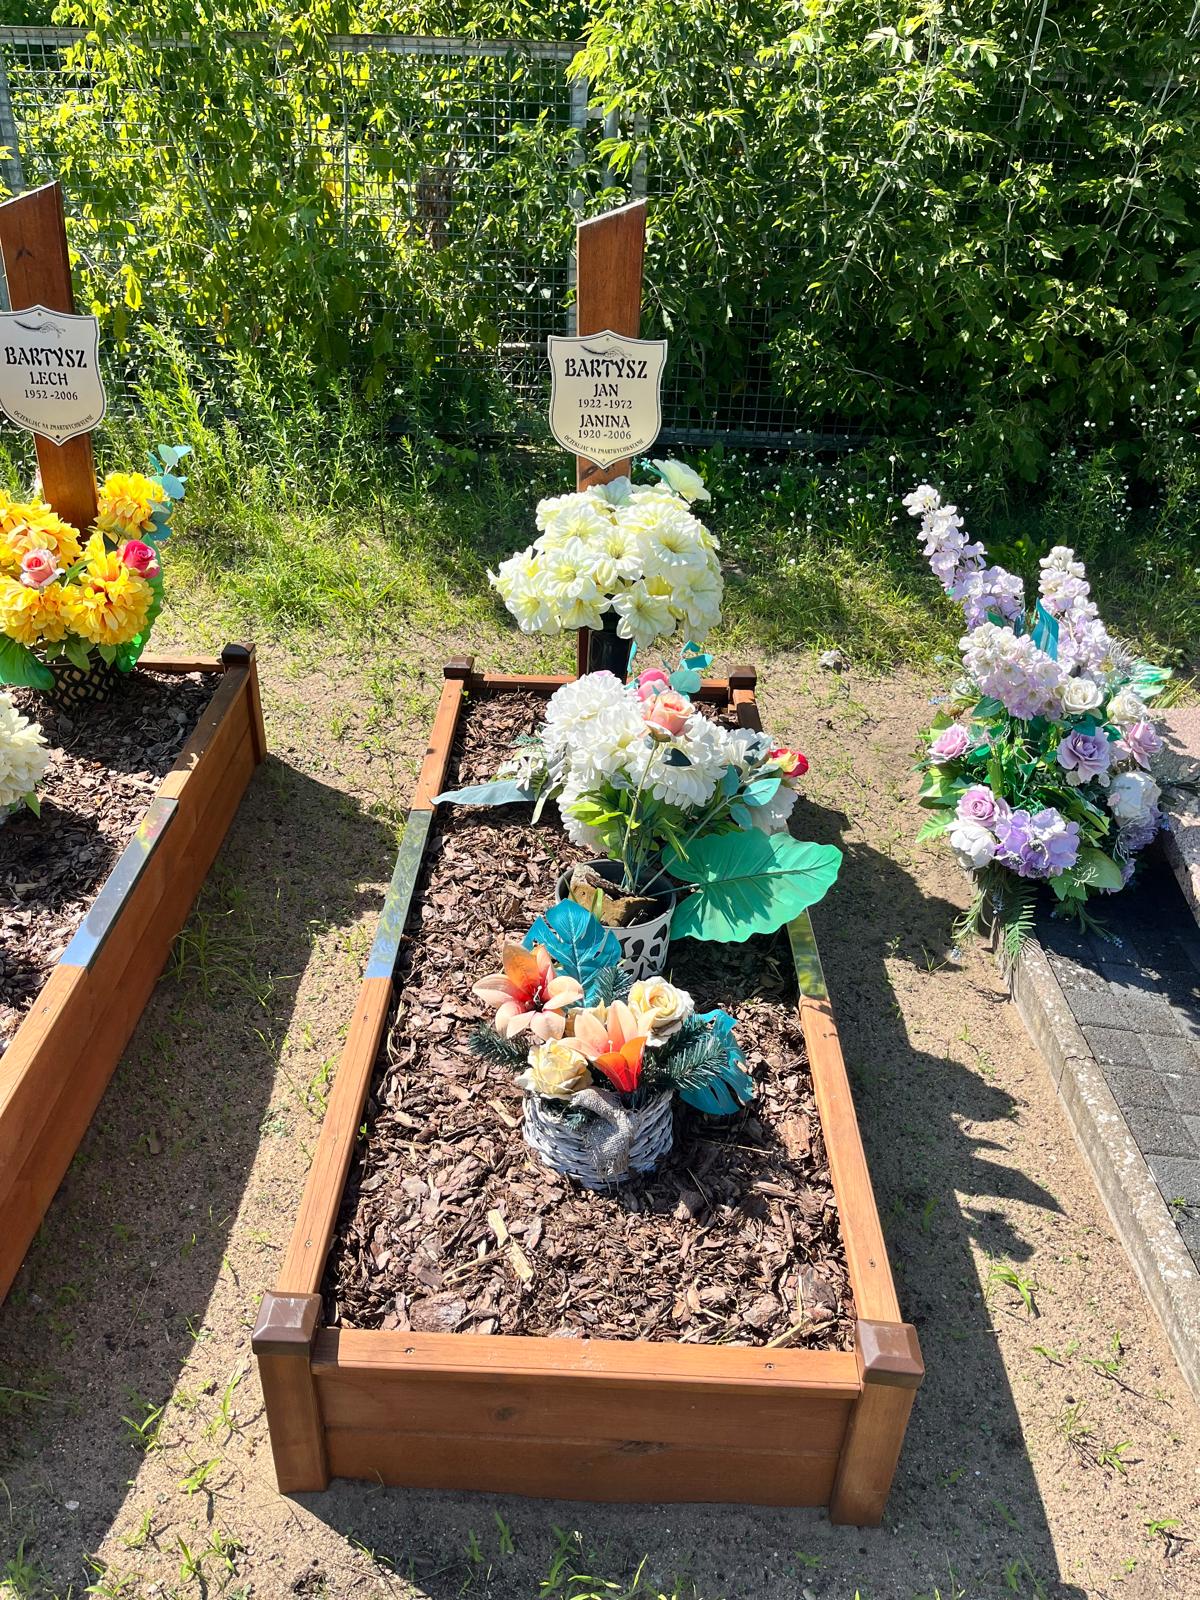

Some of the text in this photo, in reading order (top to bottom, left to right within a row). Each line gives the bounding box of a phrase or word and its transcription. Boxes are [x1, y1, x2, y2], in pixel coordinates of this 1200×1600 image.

[4, 346, 88, 368] BARTYSZ
[564, 358, 648, 379] BARTYSZ
[29, 371, 69, 386] LECH
[593, 383, 619, 397] JAN
[579, 414, 630, 428] JANINA
